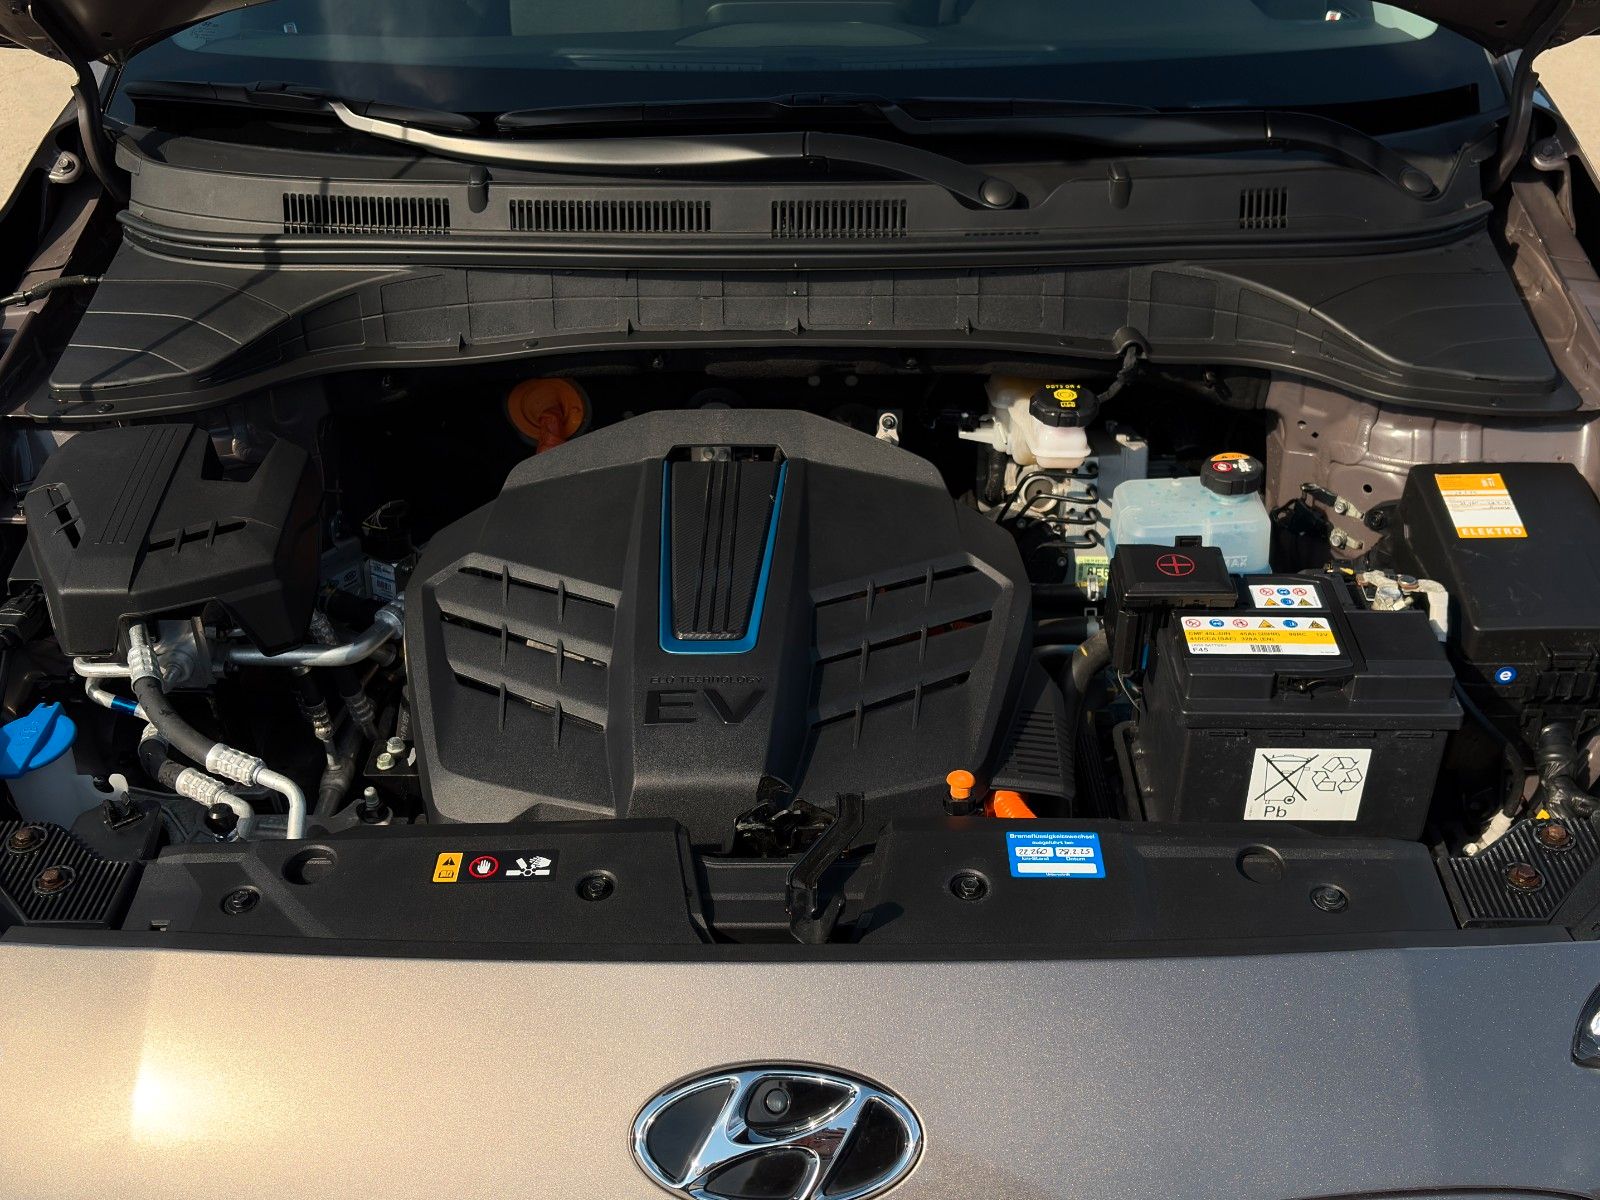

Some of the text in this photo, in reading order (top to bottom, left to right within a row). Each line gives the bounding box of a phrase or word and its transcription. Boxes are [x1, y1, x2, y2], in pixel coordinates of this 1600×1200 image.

[1461, 527, 1522, 536] ELEKTRO
[650, 675, 763, 684] ECO TECHNOLOGY
[1499, 670, 1512, 681] e
[643, 688, 766, 725] EV
[1263, 805, 1287, 818] Pb
